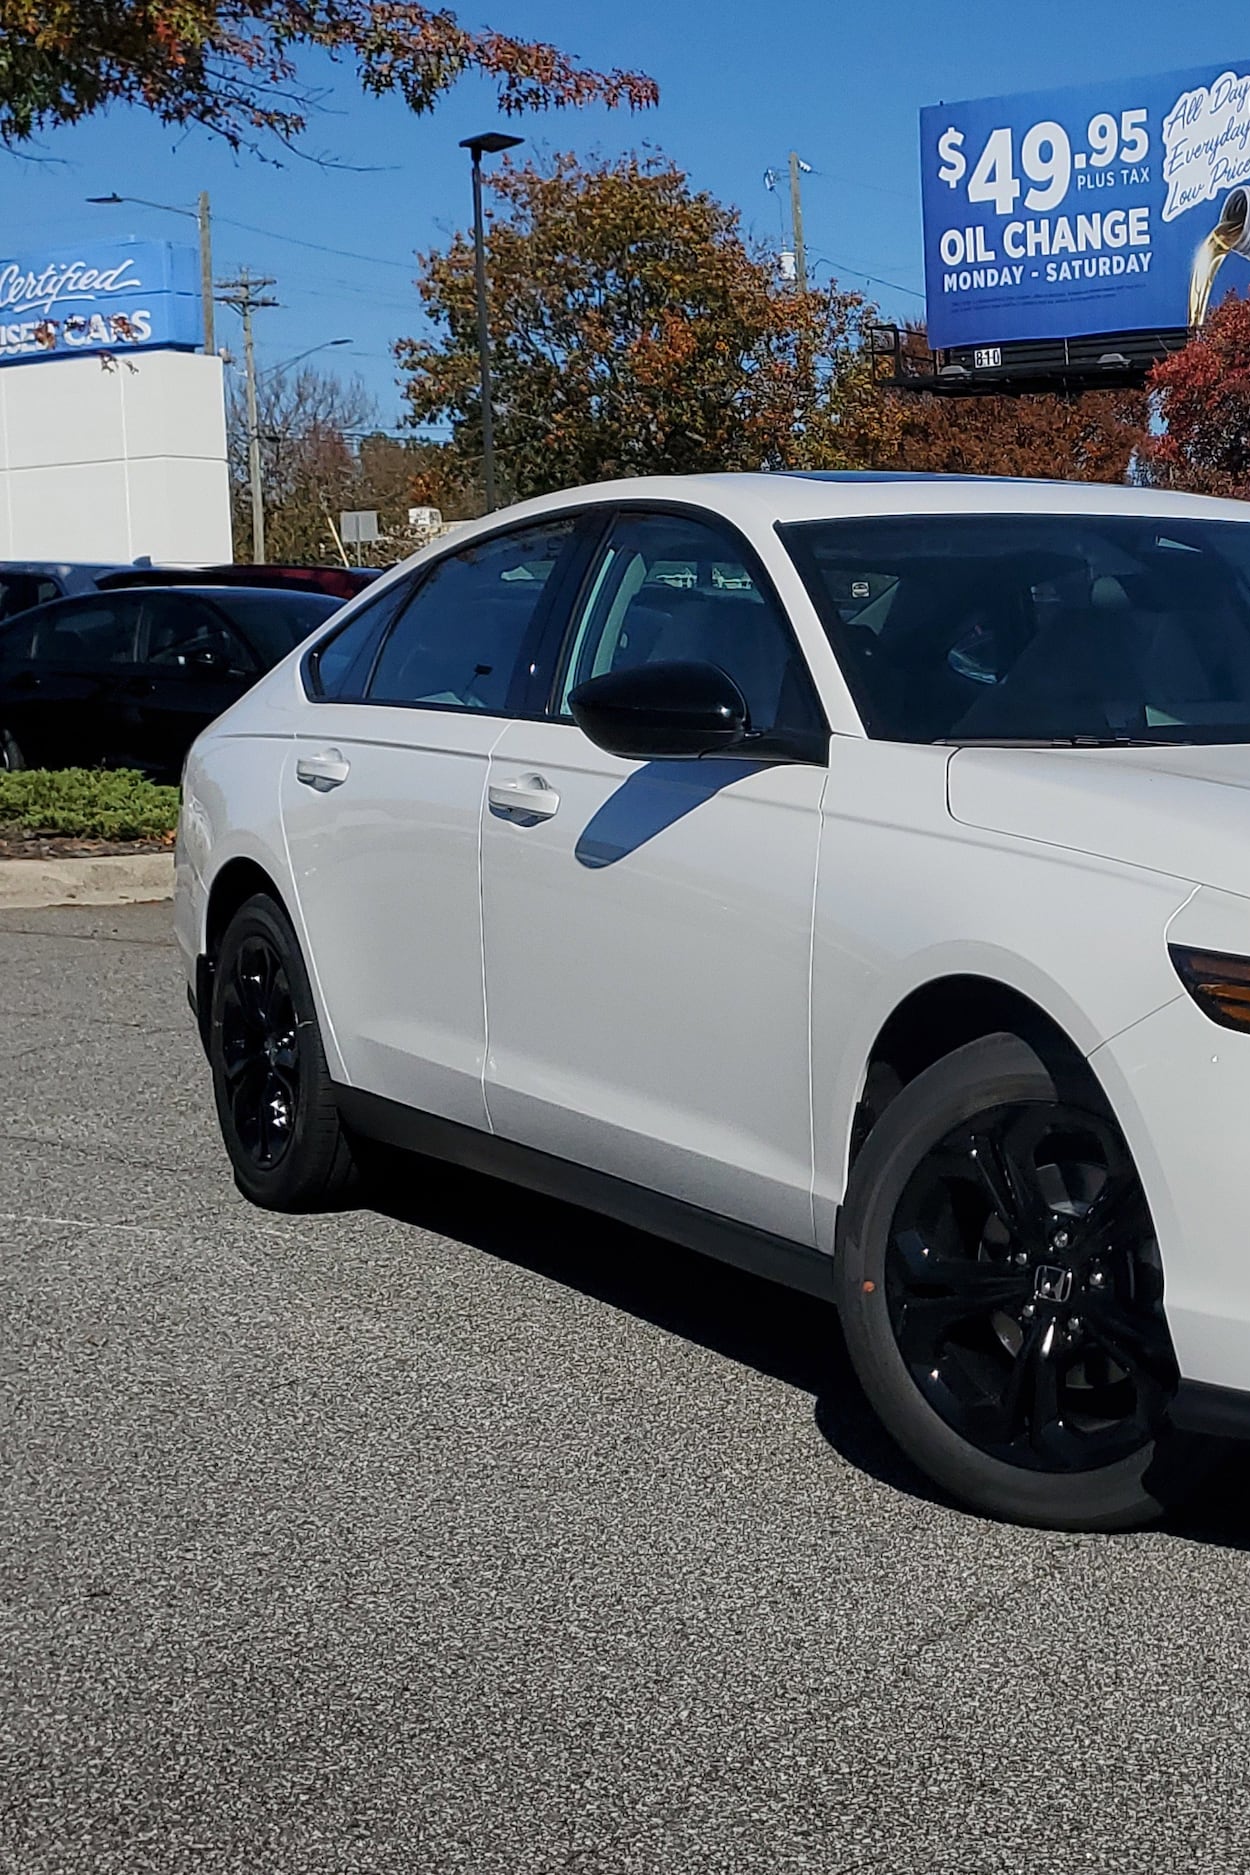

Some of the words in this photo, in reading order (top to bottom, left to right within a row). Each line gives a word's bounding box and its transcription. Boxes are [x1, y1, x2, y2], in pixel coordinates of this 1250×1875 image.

[1167, 94, 1204, 138] All
[938, 108, 1149, 215] $49.95
[1077, 172, 1115, 191] PLUS
[1121, 167, 1150, 185] TAX
[1167, 181, 1205, 216] Low
[940, 226, 996, 266] OIL
[1003, 207, 1150, 259] CHANGE
[0, 259, 141, 314] Certified
[943, 266, 1024, 292] MONDAY
[1046, 252, 1153, 282] SATURDAY
